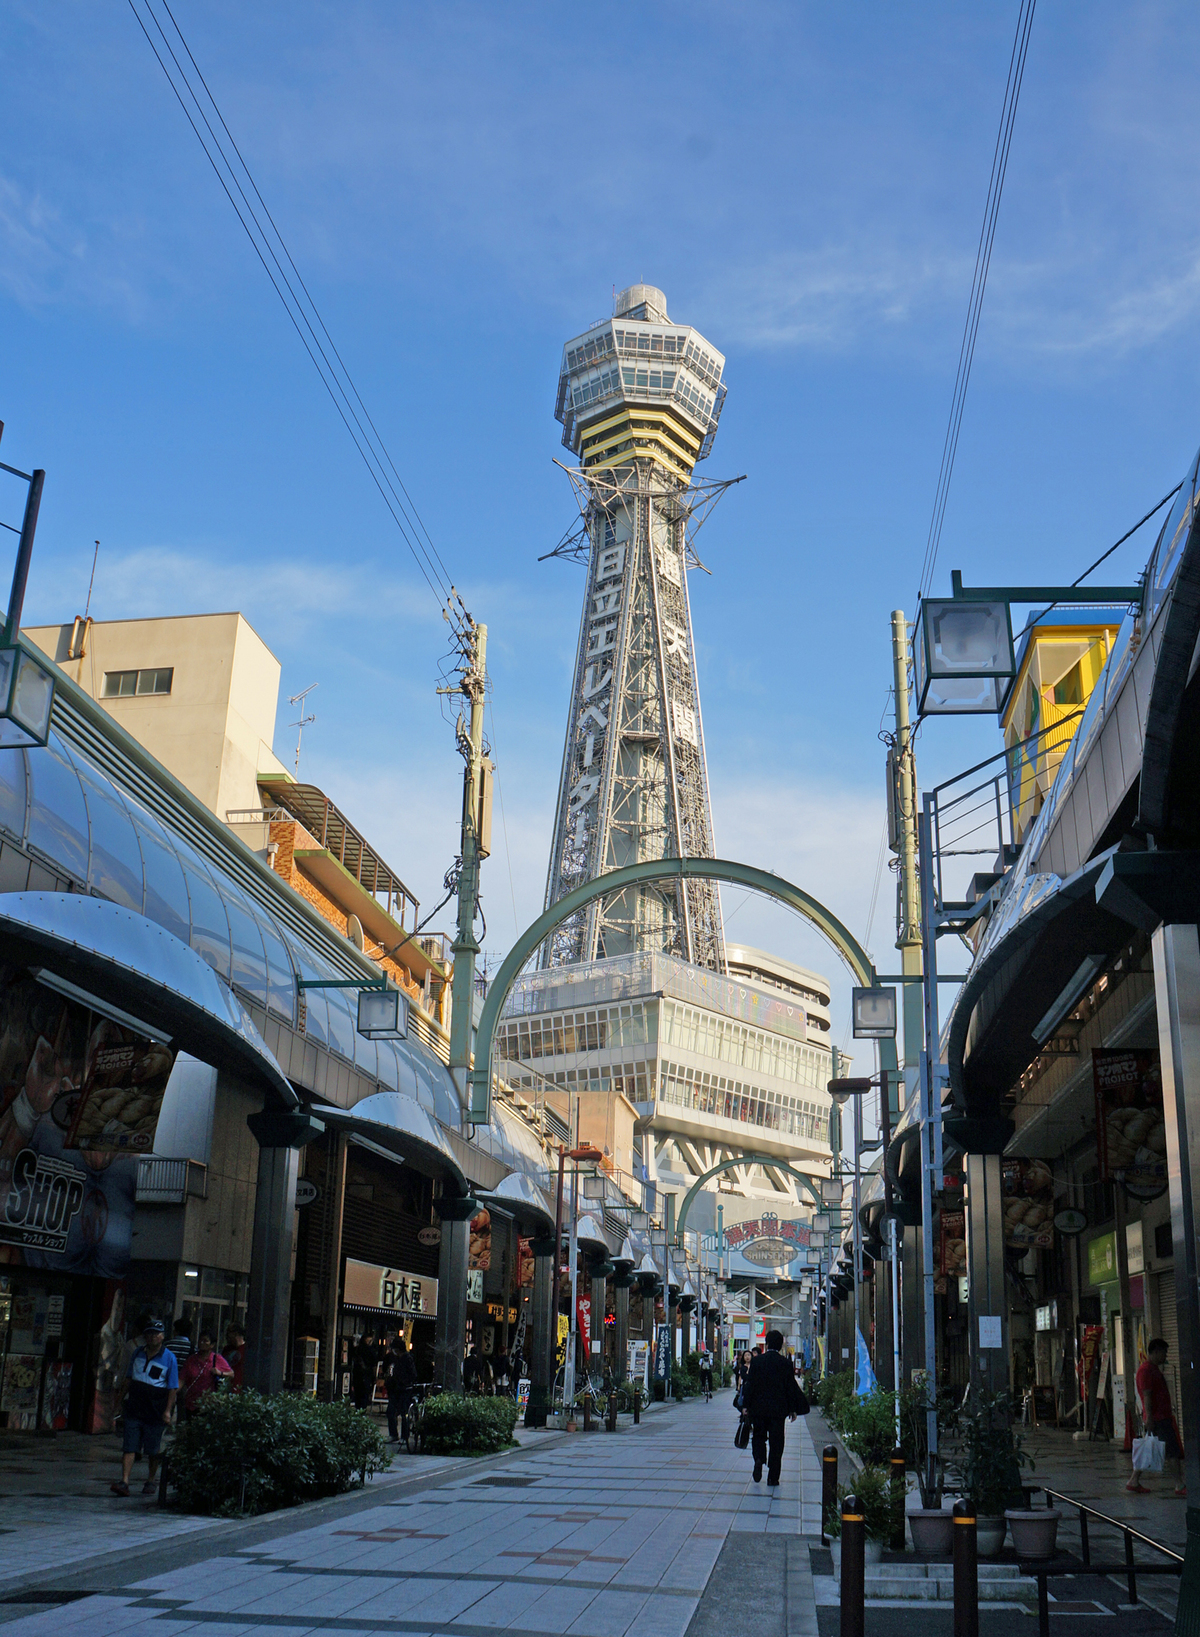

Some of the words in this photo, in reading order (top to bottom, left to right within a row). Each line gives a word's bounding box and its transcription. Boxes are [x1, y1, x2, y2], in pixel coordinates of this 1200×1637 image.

[657, 546, 699, 748] 通天閣
[569, 541, 625, 850] 日立エレベーター
[94, 1059, 133, 1071] PROJECT
[1098, 1071, 1139, 1087] PROJECT
[5, 1148, 85, 1234] SHOP
[384, 1269, 422, 1312] 白木屋
